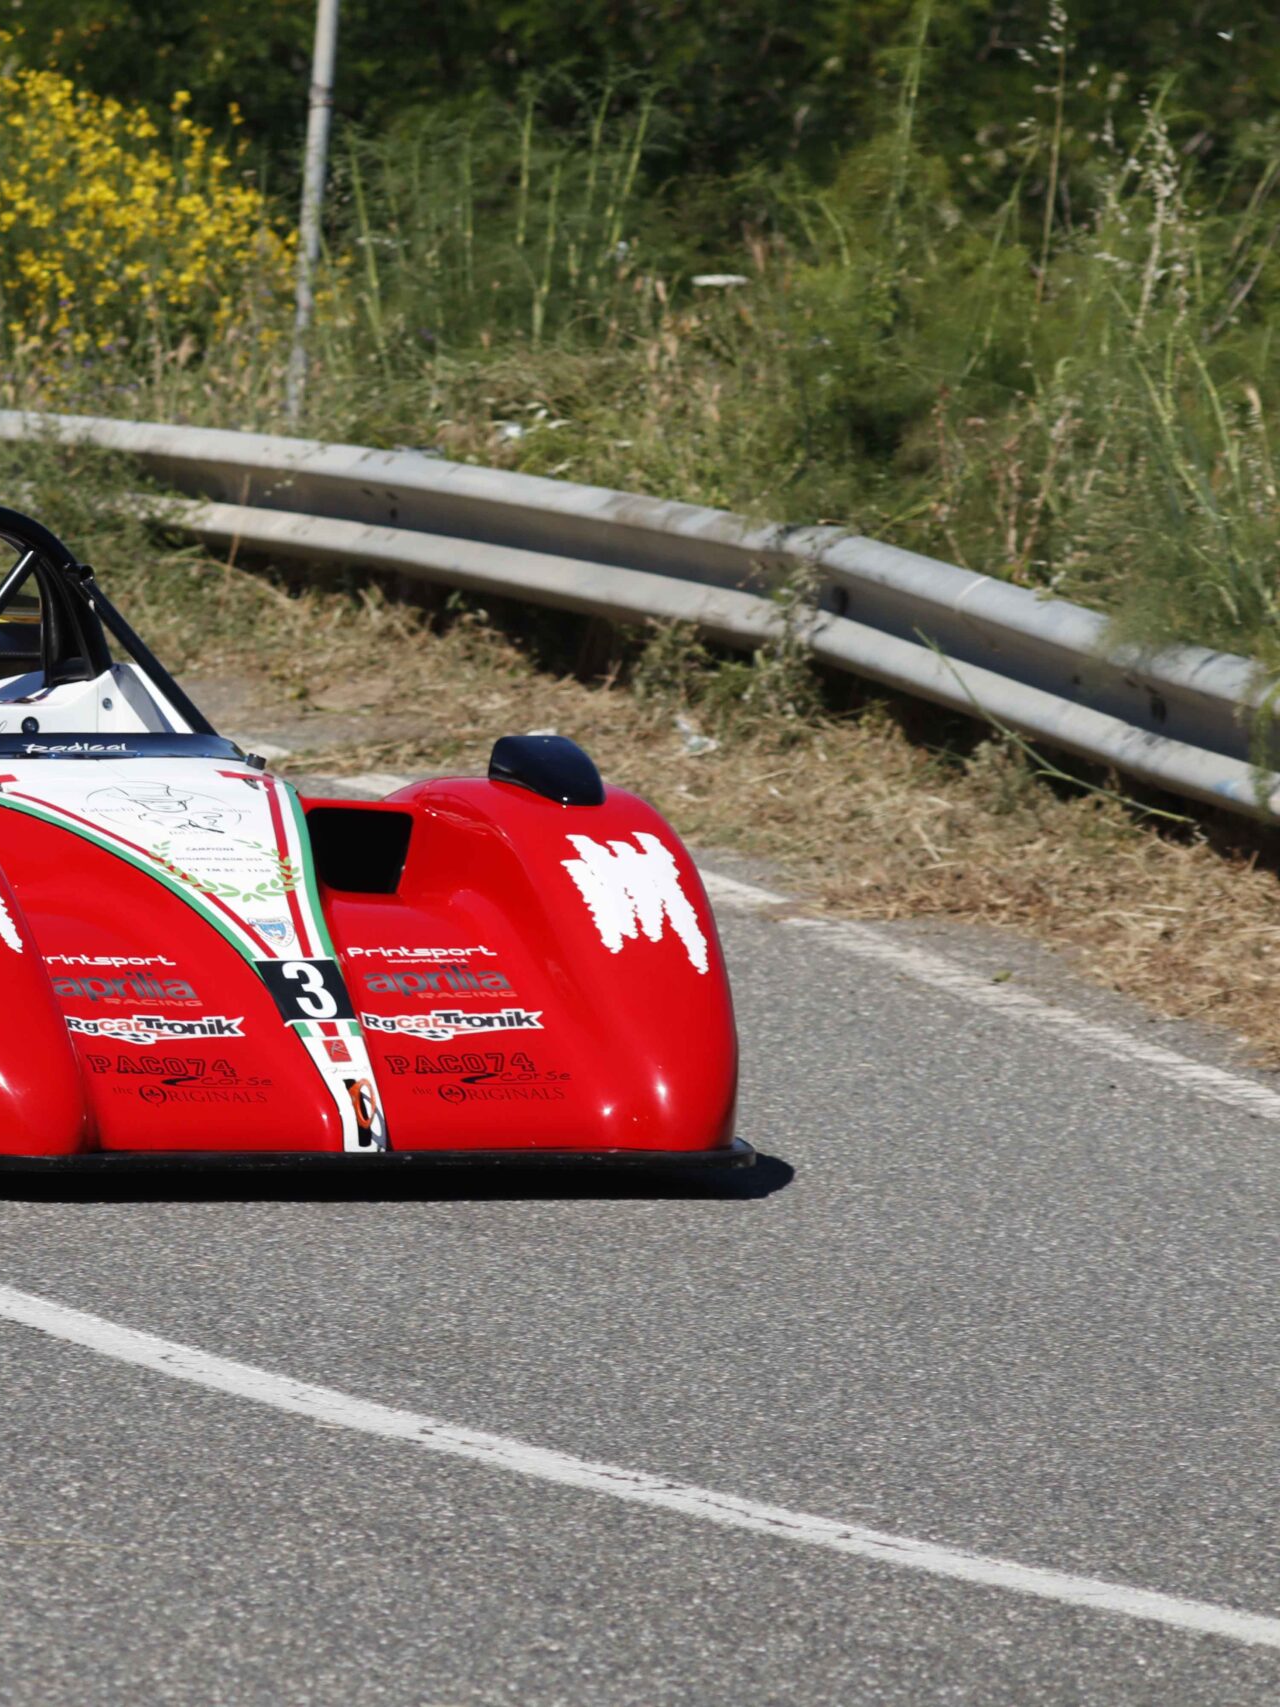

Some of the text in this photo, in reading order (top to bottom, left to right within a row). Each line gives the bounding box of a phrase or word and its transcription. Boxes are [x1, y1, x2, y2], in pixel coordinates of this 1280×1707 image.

[22, 742, 128, 755] Radical
[42, 954, 176, 968] rintsport
[347, 945, 497, 959] Printsport
[53, 971, 198, 1001] aprilia
[363, 965, 512, 996] aprilia
[282, 961, 338, 1019] 3
[417, 991, 518, 999] RACING
[104, 997, 203, 1007] RACING
[86, 1053, 238, 1078] PACO74
[384, 1052, 536, 1075] PACO74
